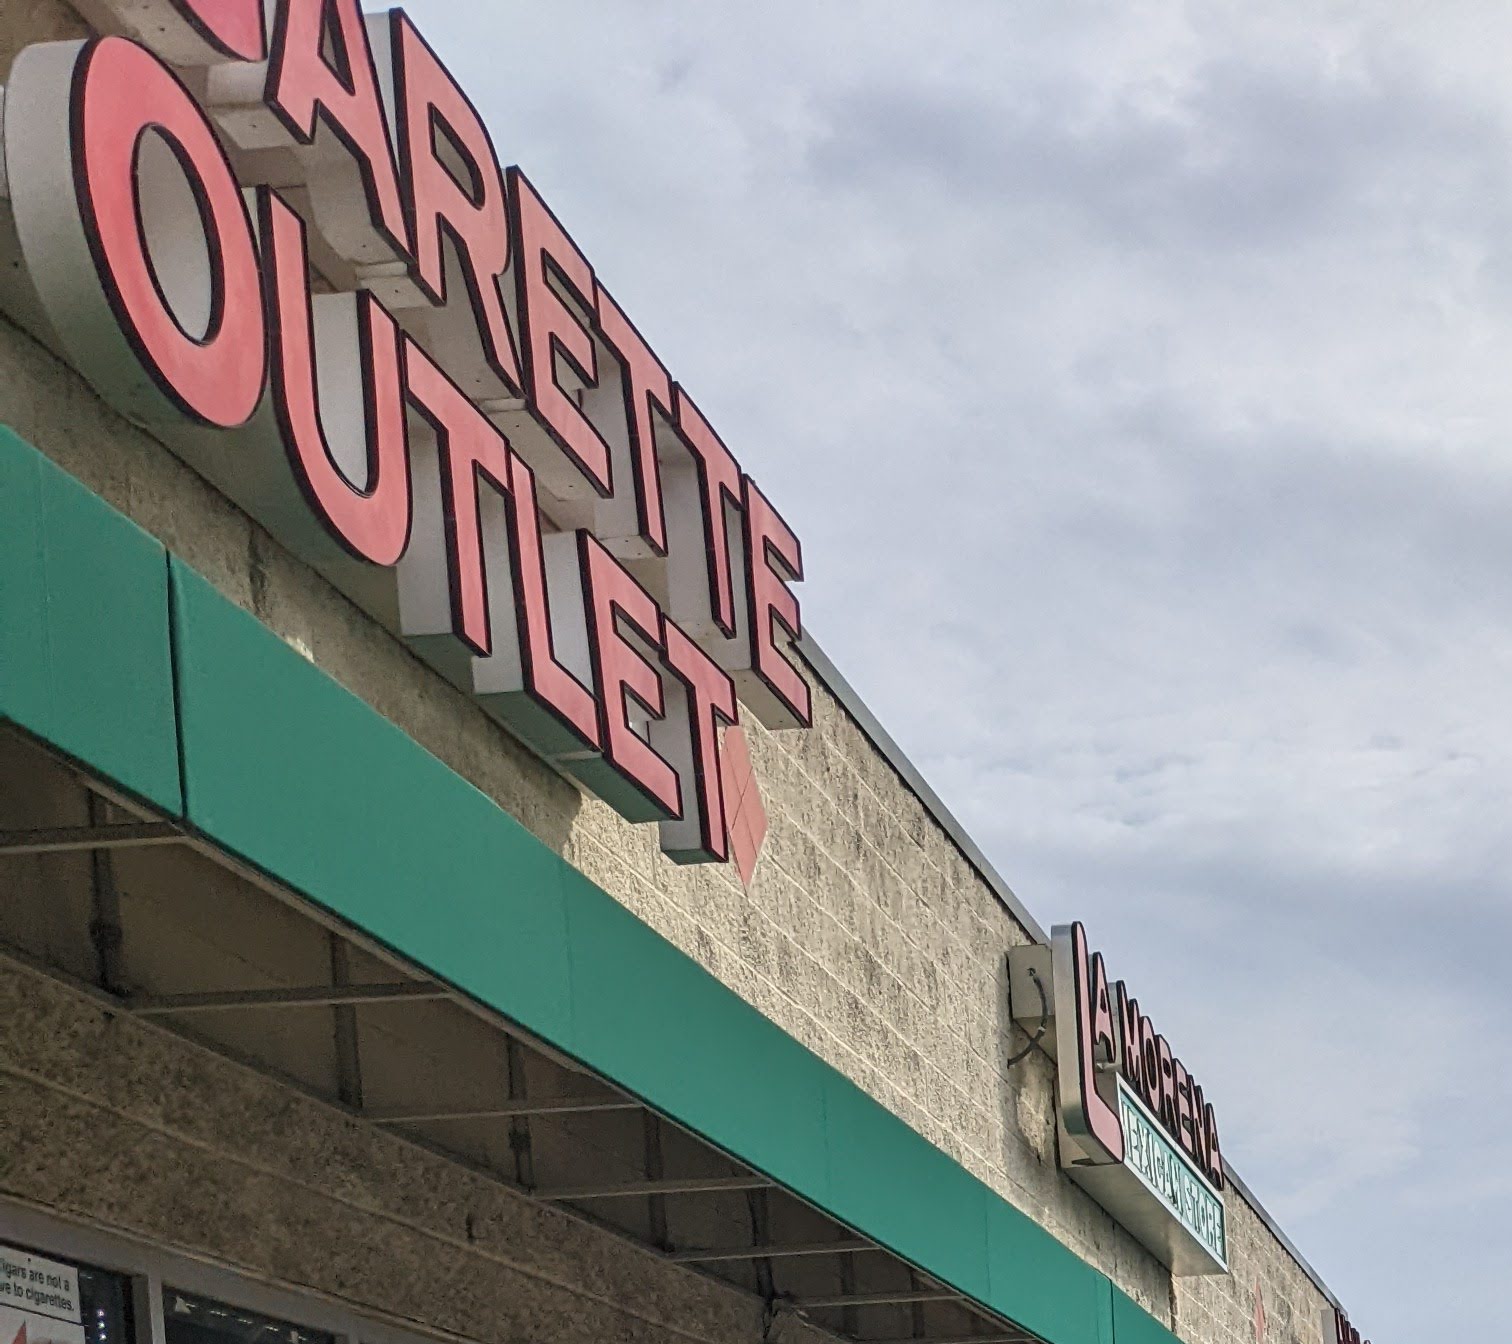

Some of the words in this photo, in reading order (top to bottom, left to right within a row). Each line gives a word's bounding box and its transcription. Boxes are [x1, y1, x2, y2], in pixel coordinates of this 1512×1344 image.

[70, 36, 728, 863] OUTLET
[169, 0, 812, 728] ARETTE
[1071, 921, 1124, 1164] LA
[1116, 980, 1224, 1192] MORENA
[0, 1258, 27, 1280] igars
[29, 1268, 44, 1284] are
[46, 1273, 61, 1290] not
[64, 1280, 70, 1291] a
[13, 1281, 23, 1297] to
[1184, 1174, 1224, 1258] STORE
